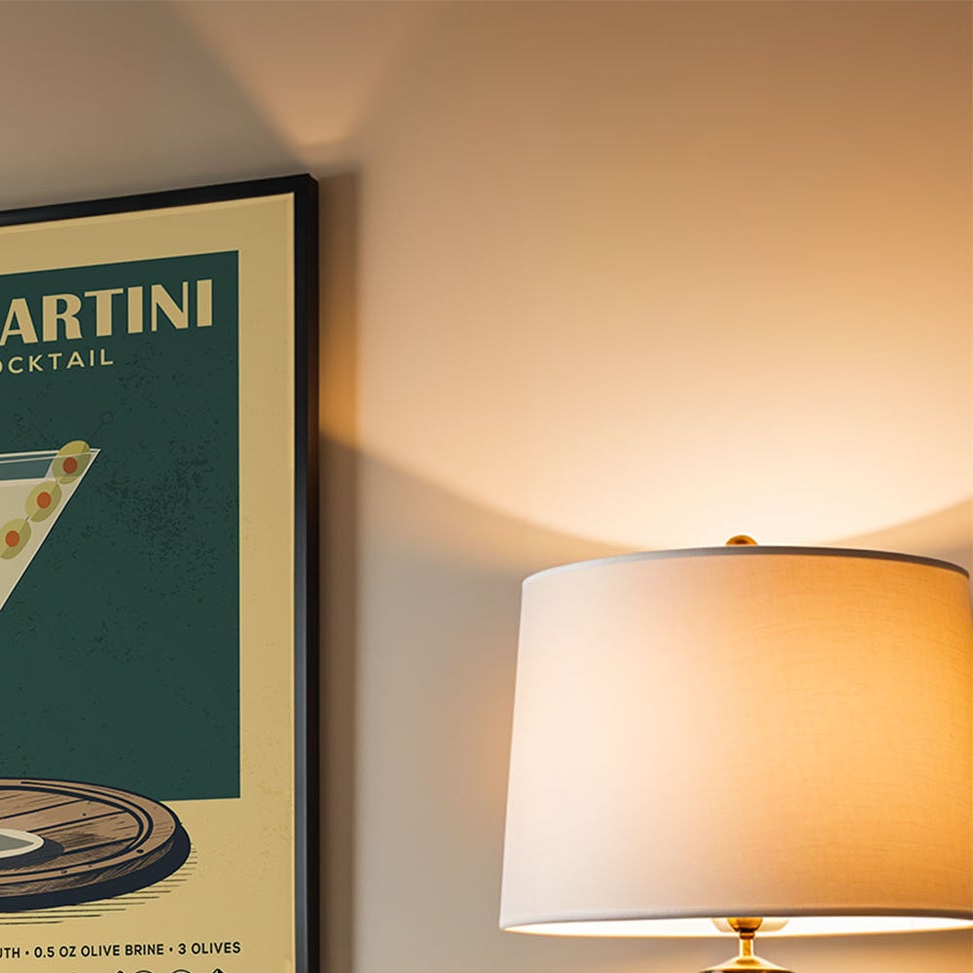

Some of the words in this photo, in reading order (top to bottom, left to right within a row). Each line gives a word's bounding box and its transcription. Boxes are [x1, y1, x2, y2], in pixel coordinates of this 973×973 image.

[34, 946, 55, 958] 0.5
[59, 946, 77, 957] OZ
[81, 944, 120, 957] OLIVE
[125, 944, 164, 956] BRINE
[178, 942, 187, 955] 3
[191, 941, 241, 955] OLIVES
